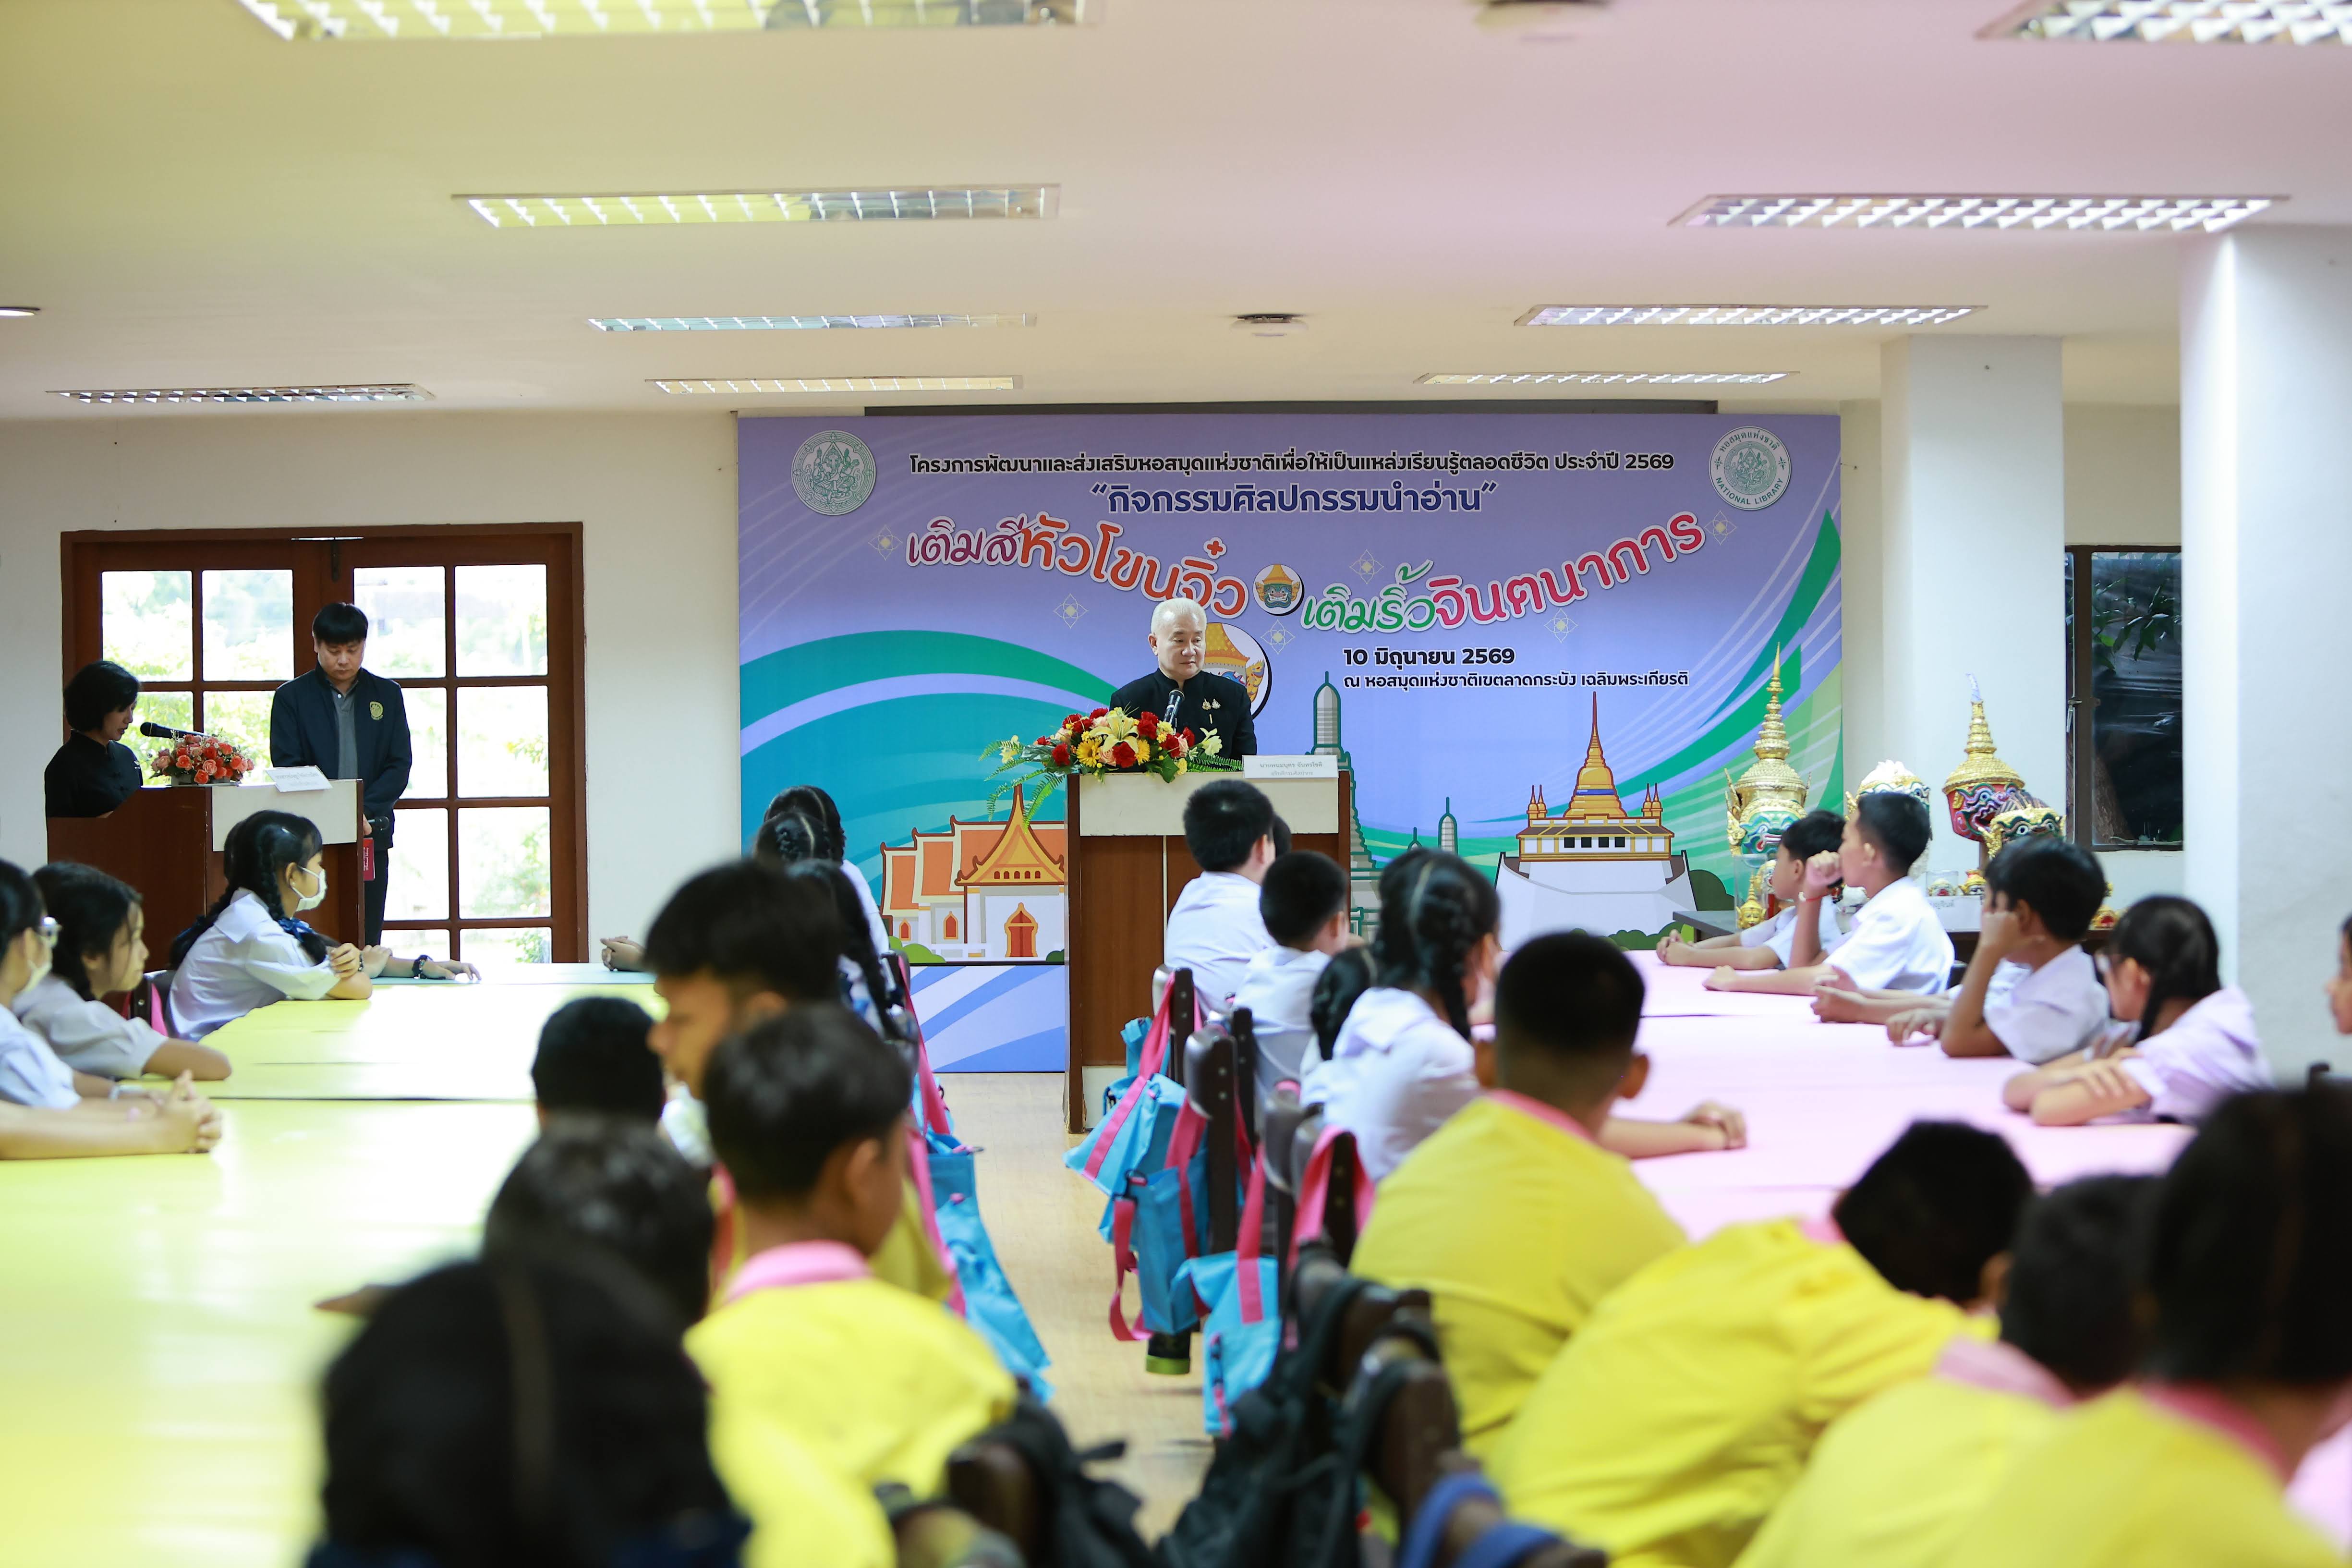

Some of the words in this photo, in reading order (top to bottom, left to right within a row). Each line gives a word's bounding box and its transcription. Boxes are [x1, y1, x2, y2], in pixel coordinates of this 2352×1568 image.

[1719, 430, 1780, 452] หอสมุดแห่งชาติ
[909, 448, 1549, 475] โครงการพัฒนาและส่งเสริมหอสมุดแห่งชาติเพื่อให้เป็นแหล่งเรียนรู้ตลอดชีวิต
[1554, 451, 1620, 469] ประจำปี
[1625, 454, 1674, 469] 2569
[1716, 477, 1751, 505] NATIONAL
[1755, 478, 1783, 504] LIBRARY
[1344, 649, 1368, 665] 10
[1375, 648, 1455, 670] มิถุนายน
[1462, 648, 1515, 664] 2569
[1344, 676, 1360, 687] ณ
[1365, 671, 1576, 691] หอสมุดแห่งชาติเขตลาดกระบัง
[1581, 670, 1689, 686] เฉลิมพระเกียรติ
